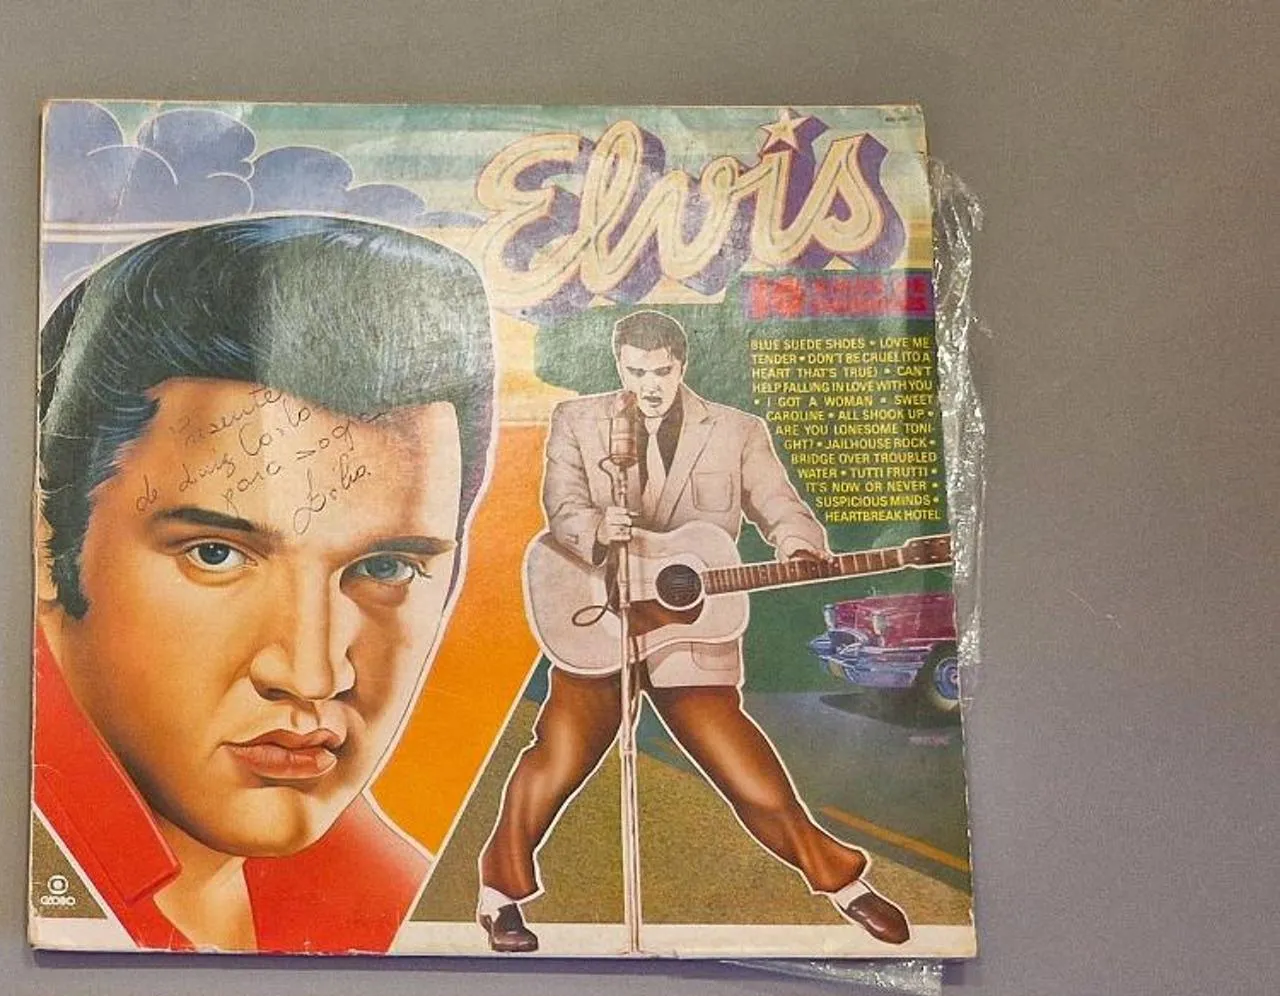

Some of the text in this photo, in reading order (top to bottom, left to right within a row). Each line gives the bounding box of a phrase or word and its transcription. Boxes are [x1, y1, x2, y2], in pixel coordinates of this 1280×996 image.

[475, 107, 908, 312] Elvis
[750, 336, 931, 350] BLUE SUEDE SHOES LOVE ME
[752, 354, 796, 364] TENDER
[846, 353, 861, 363] BE
[922, 351, 931, 361] A
[752, 368, 790, 379] HEART
[797, 368, 837, 378] THAT'S
[844, 367, 878, 378] TRUE)
[752, 379, 933, 393] HELP FALLING IN LOVE WITH YOU
[778, 396, 802, 407] GOT
[808, 396, 818, 406] A
[824, 395, 873, 406] WOMAN
[894, 394, 933, 405] SWEET
[766, 408, 924, 421] CAROLINE ALL SHOOK UP
[776, 424, 798, 435] ARE
[805, 423, 829, 434] YOU
[833, 423, 898, 434] LONESOME
[825, 438, 892, 449] JAILHOUSE
[894, 437, 928, 448] ROCK
[791, 452, 937, 465] BRIDGE OVER TROUBLED
[798, 466, 928, 479] WATER TUTTI FRUTTI
[832, 481, 861, 493] NOW
[864, 481, 882, 492] OR
[886, 480, 927, 491] NEVER
[815, 495, 931, 508] SUSPICIOUS MINDS
[825, 508, 941, 522] HEARTBREAK HOTEL
